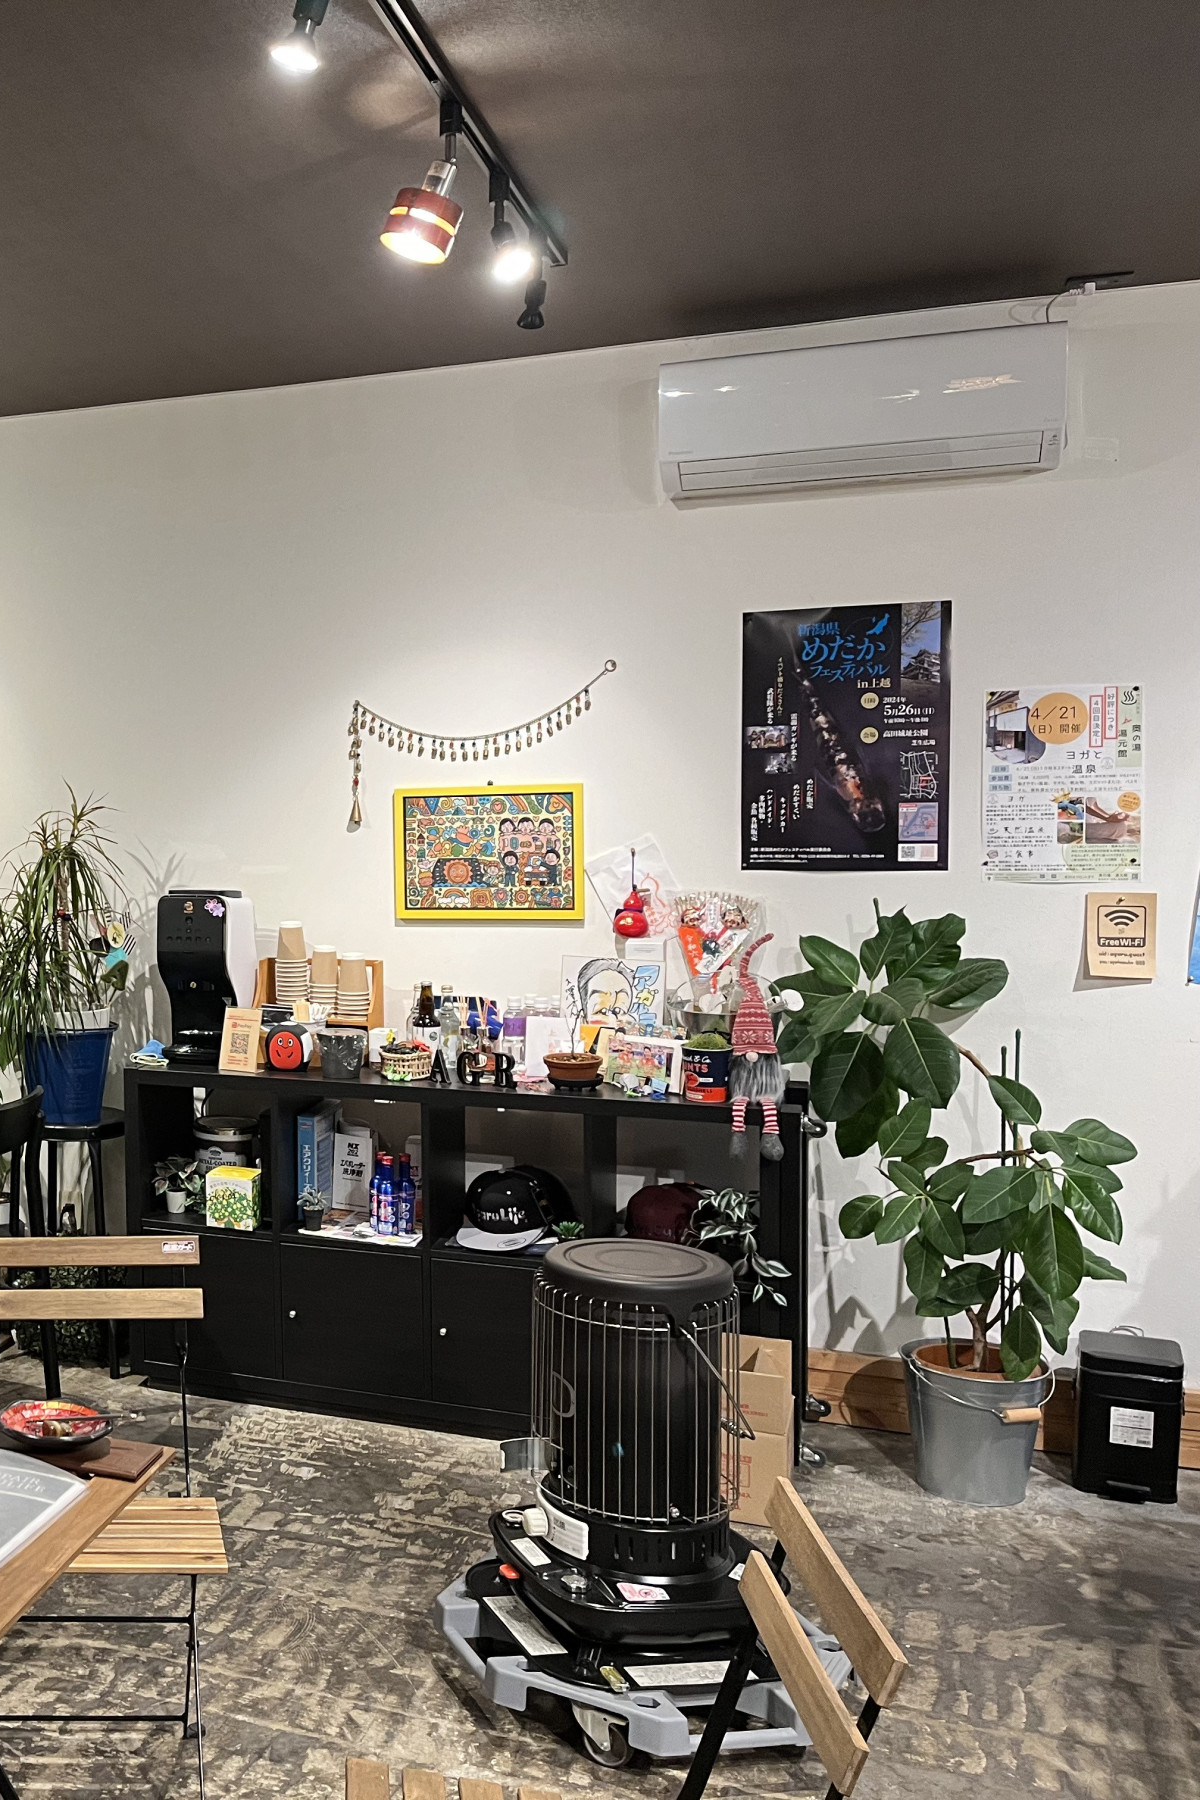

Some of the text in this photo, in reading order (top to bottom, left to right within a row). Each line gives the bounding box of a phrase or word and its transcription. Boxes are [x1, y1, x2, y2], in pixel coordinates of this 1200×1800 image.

[799, 621, 840, 636] 新潟県
[801, 634, 886, 663] めだか
[809, 661, 891, 683] フェスティバル
[1066, 750, 1103, 760] ヨガと
[1072, 764, 1097, 774] 温泉
[492, 1051, 518, 1089] R
[342, 1168, 363, 1178] 洗浄剤
